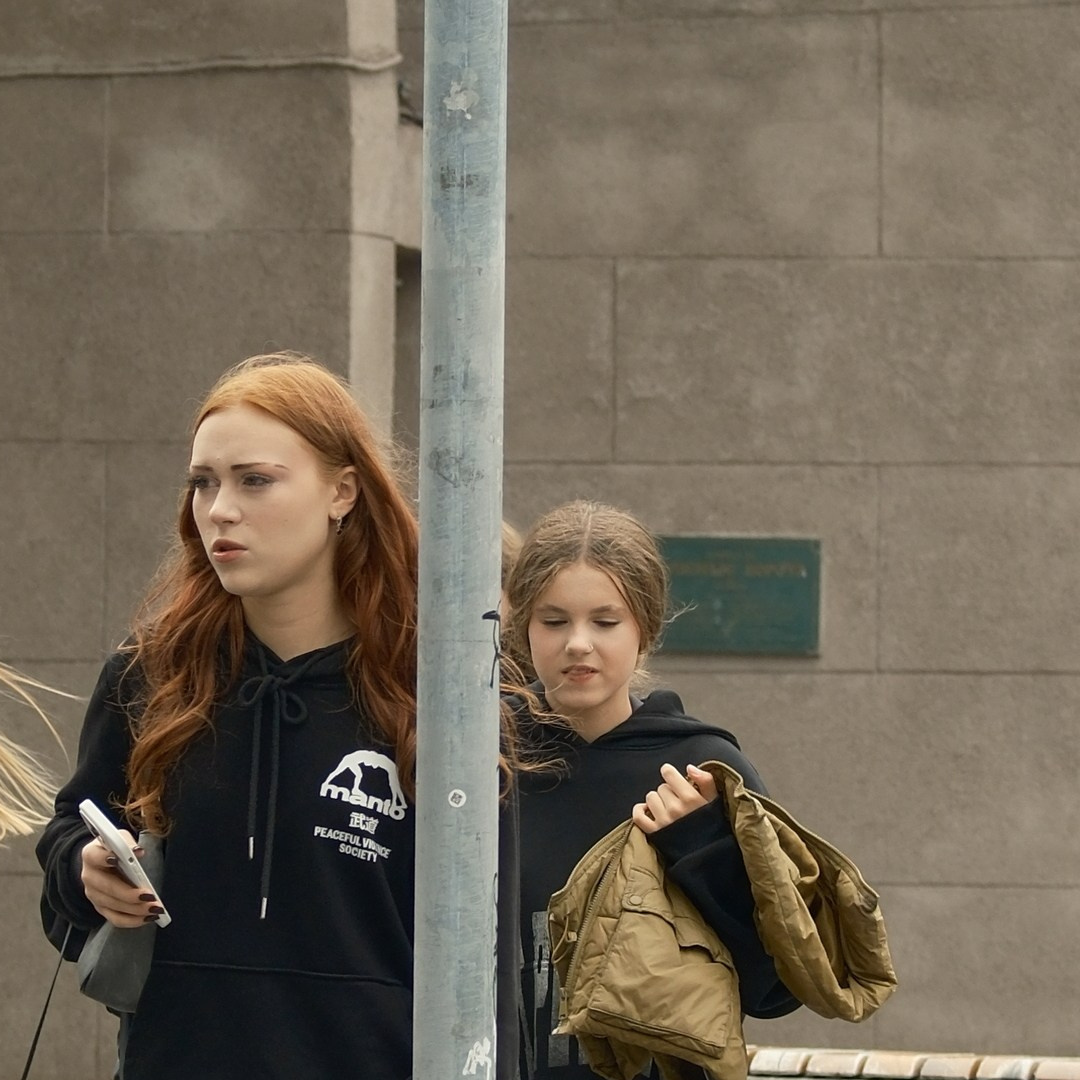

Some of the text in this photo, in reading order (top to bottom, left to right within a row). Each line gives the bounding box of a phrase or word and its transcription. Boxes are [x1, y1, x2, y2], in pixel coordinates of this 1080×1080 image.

[320, 783, 406, 821] manto
[314, 826, 362, 847] PEACEFUL
[338, 843, 378, 863] SOCIETY
